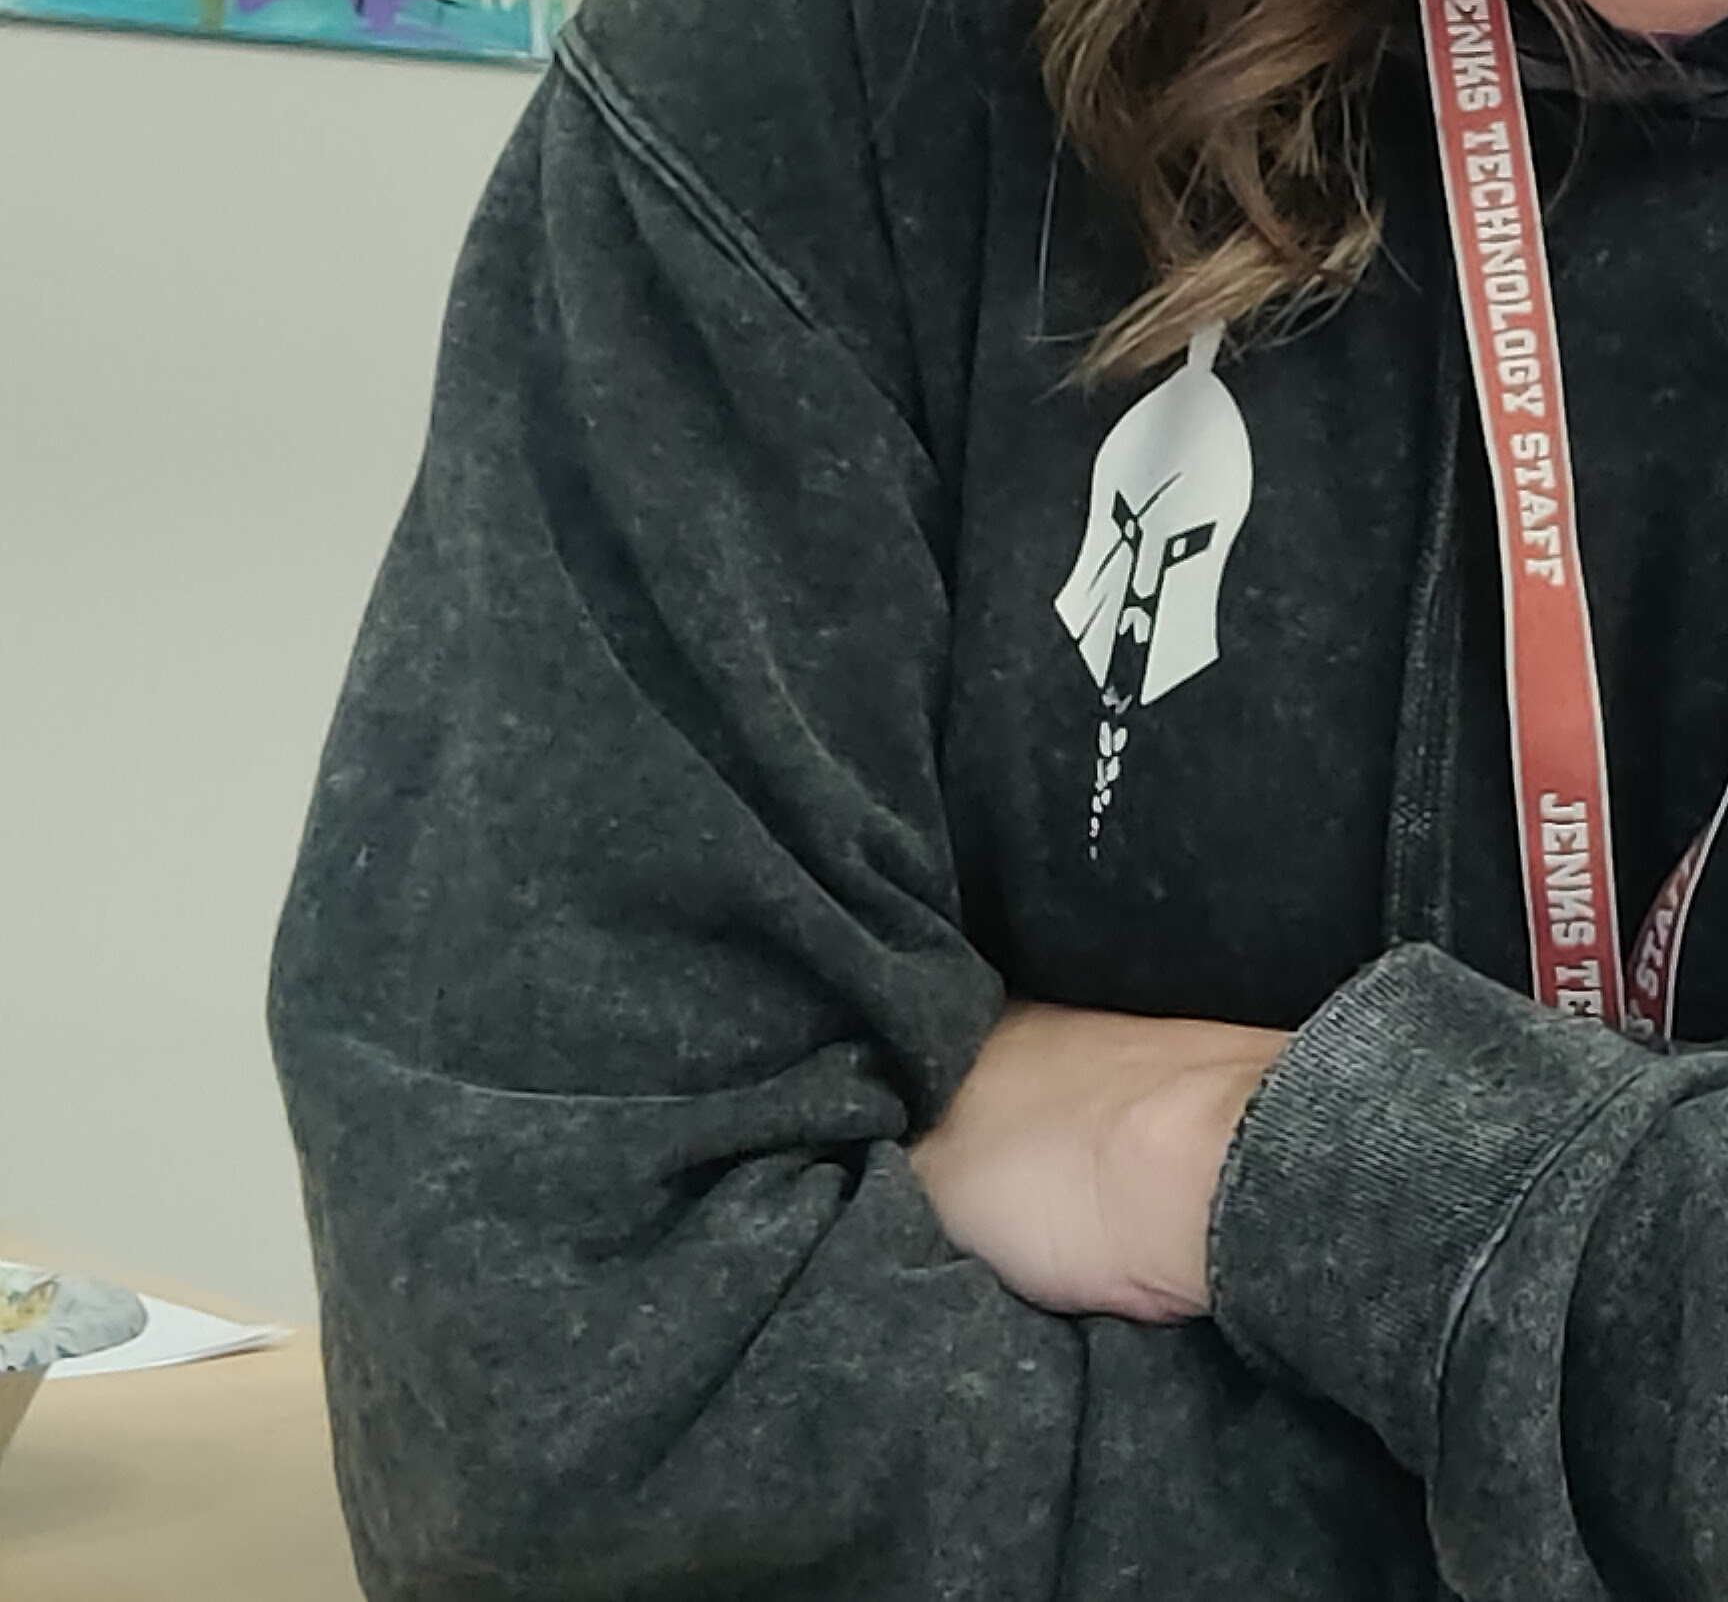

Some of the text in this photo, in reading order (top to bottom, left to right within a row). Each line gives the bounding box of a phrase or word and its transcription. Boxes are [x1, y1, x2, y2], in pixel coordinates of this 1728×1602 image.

[1462, 121, 1546, 417] TECHNOLOGY
[1510, 432, 1566, 587] STAFF
[1540, 792, 1596, 947] JENKS
